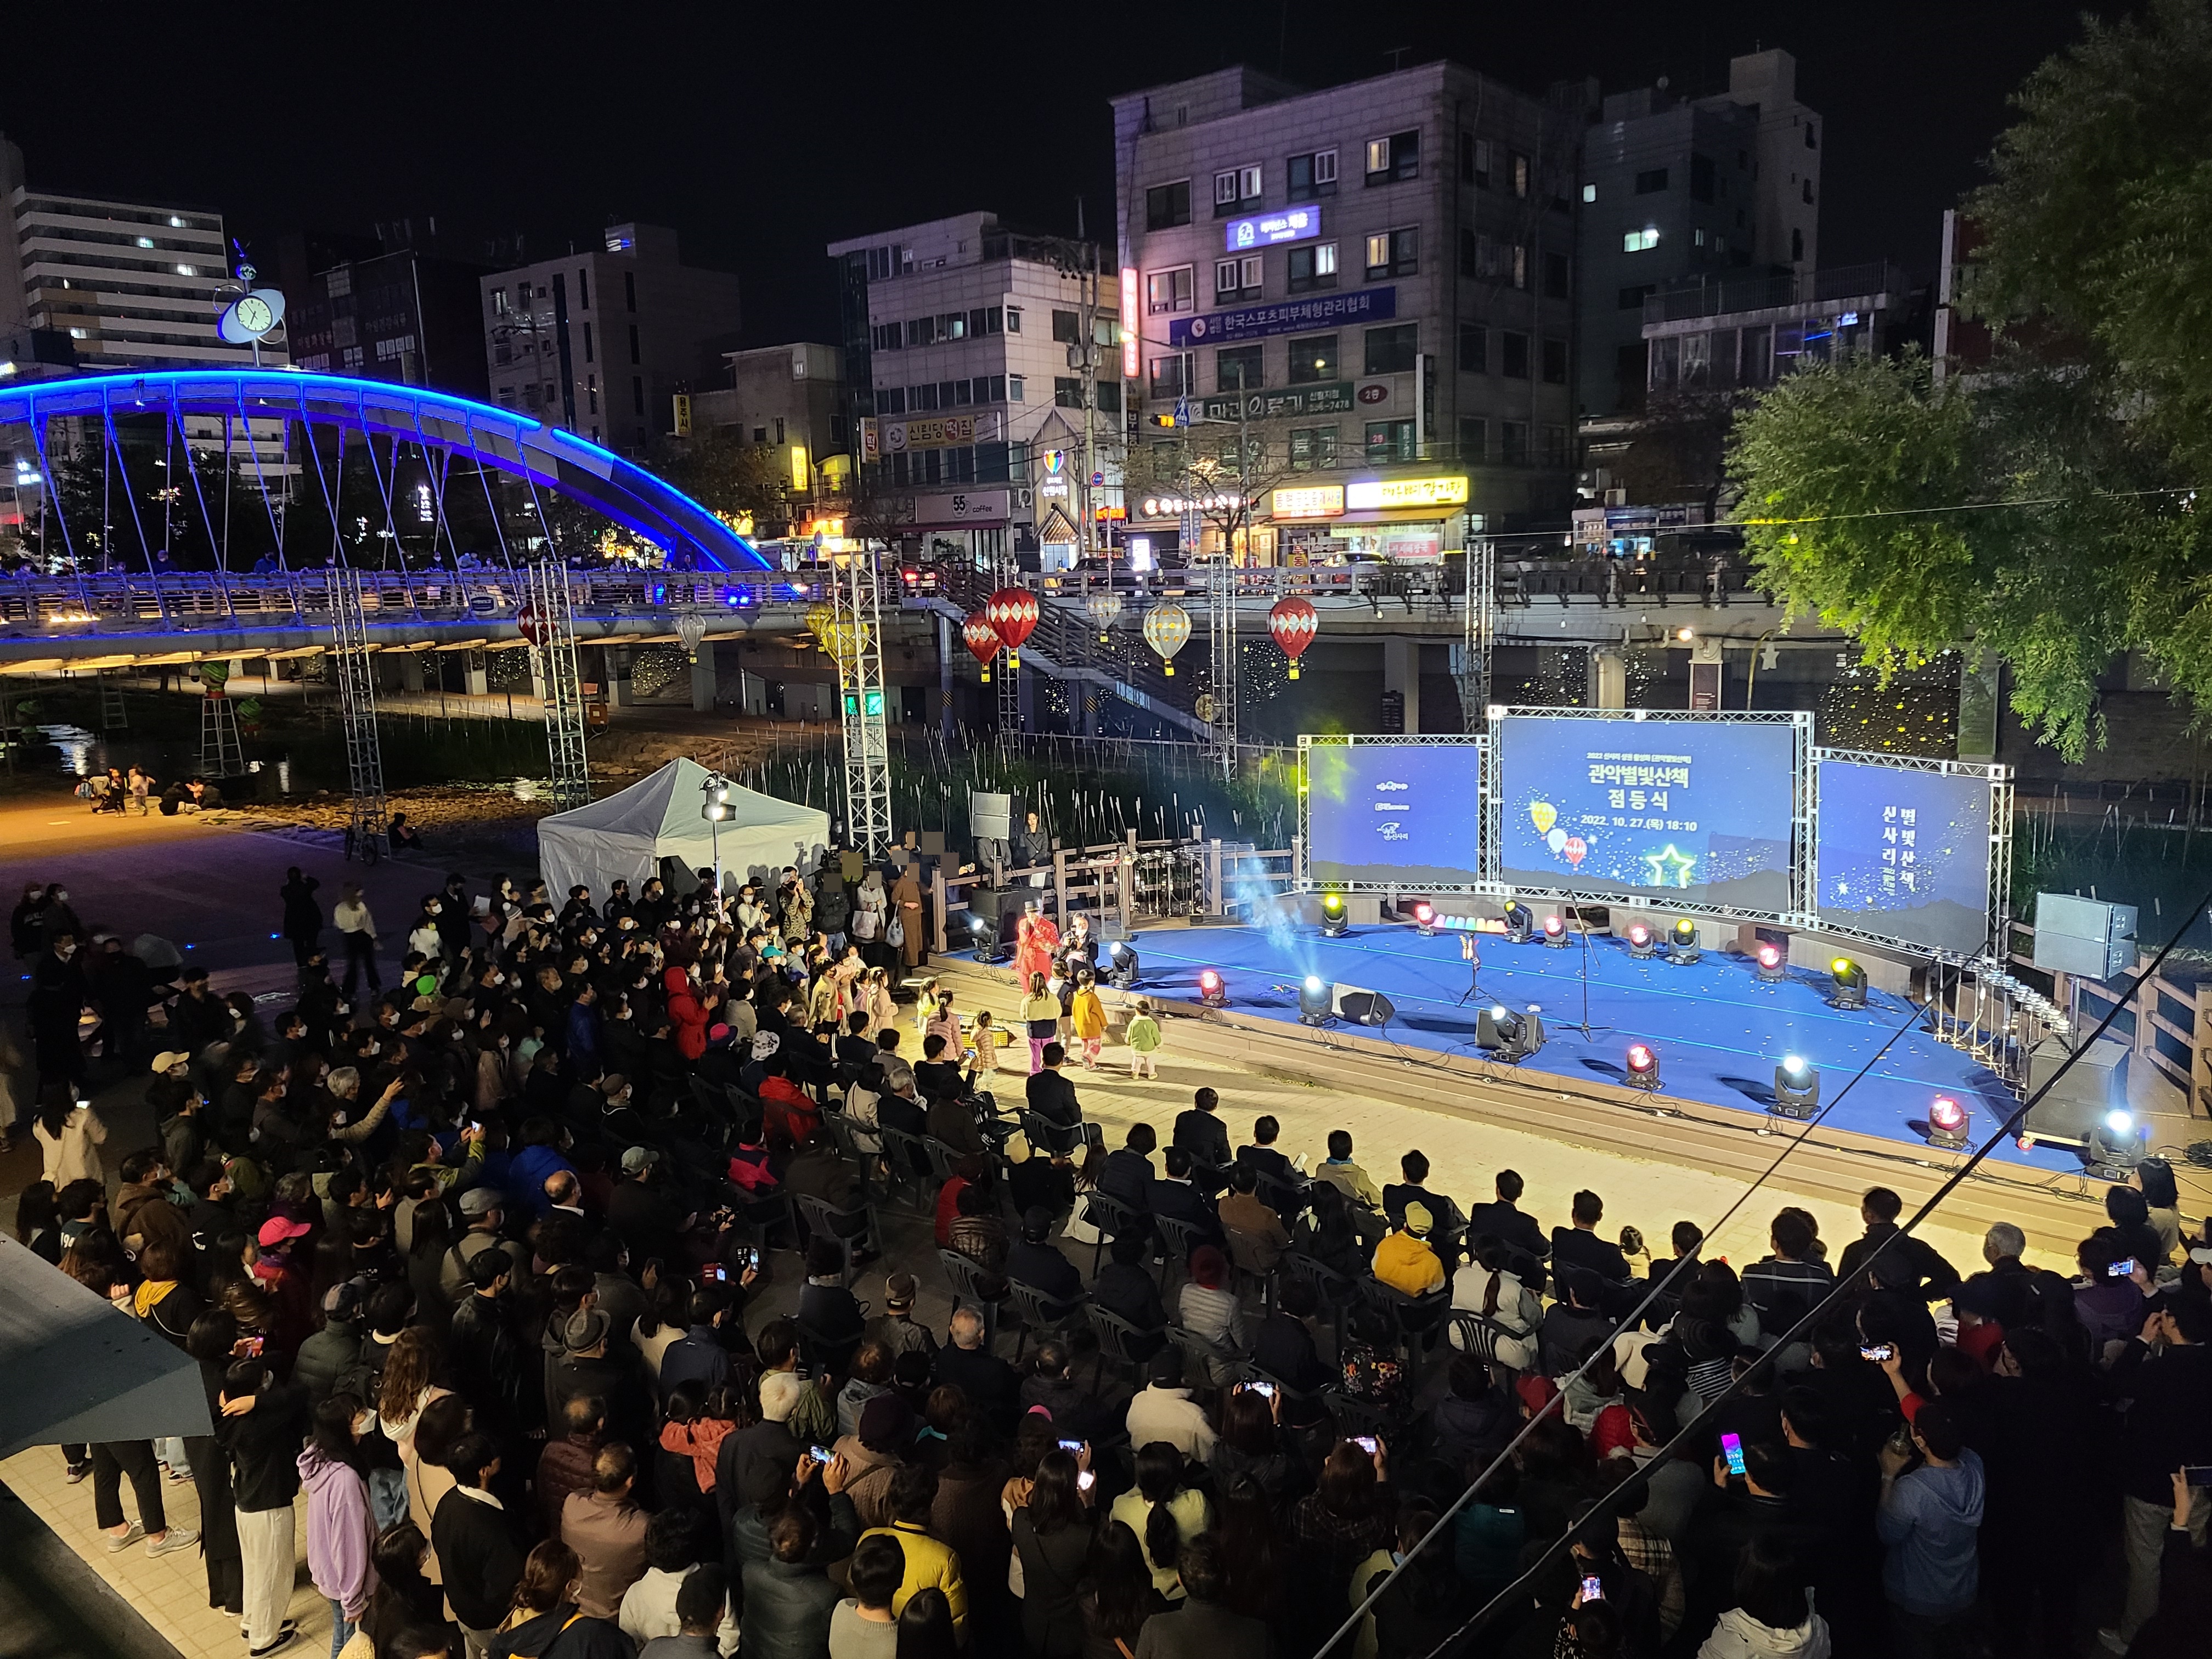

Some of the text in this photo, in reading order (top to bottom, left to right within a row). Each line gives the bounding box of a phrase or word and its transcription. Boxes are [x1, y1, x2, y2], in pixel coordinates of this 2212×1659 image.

[1224, 295, 1370, 331] 한국스포츠피부체형관리협회
[1364, 389, 1380, 400] 2층
[909, 419, 972, 441] 신림당떡집
[867, 434, 876, 449] 떡
[952, 495, 966, 511] 55
[1588, 764, 1689, 789] 관악별빛산책
[1580, 814, 1610, 826] 2022.
[1611, 816, 1628, 828] 10.
[1665, 820, 1698, 832] 18:10
[1881, 805, 1899, 867] 신사리
[1898, 808, 1916, 890] 별빛산책
